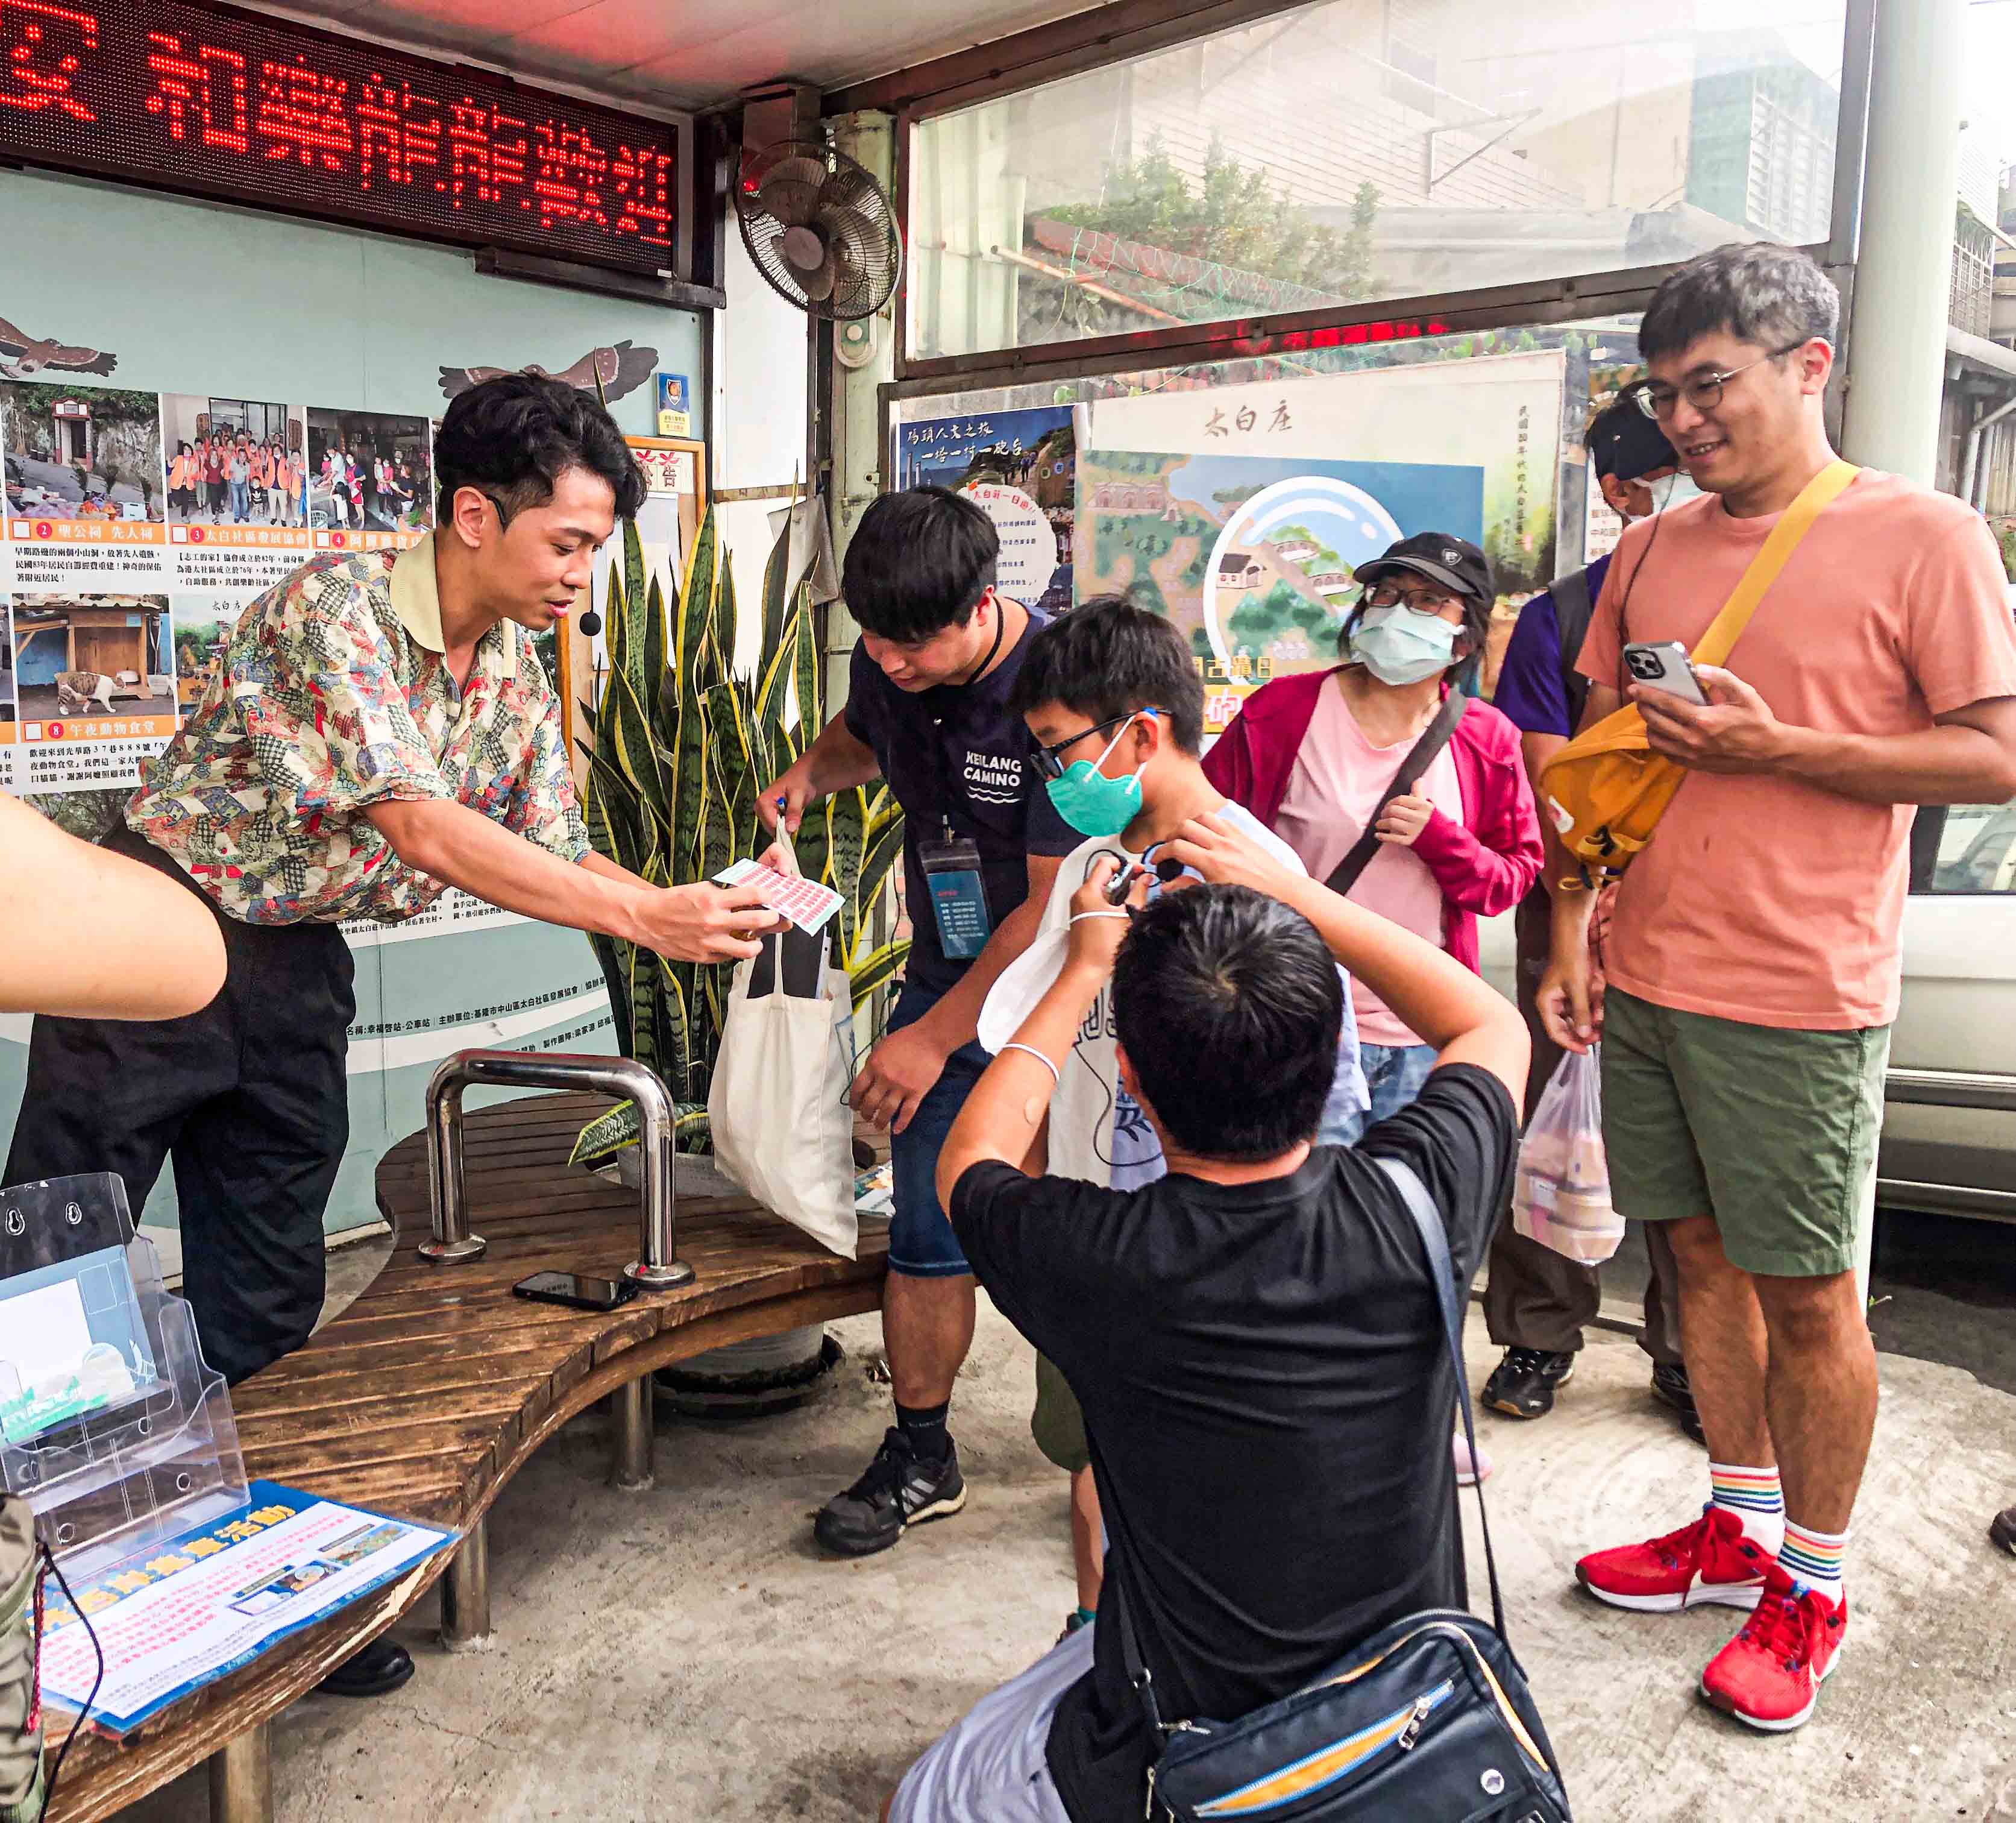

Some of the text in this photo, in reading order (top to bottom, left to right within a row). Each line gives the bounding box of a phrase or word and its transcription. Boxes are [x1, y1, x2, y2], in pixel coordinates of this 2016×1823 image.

[1204, 398, 1293, 438] 太白庄
[41, 525, 46, 535] 2
[195, 529, 306, 546] 3 太白社區發展協會
[53, 721, 155, 736] 8 午夜動物食堂
[966, 751, 1022, 773] KEILANG
[964, 767, 1020, 787] CAMINO
